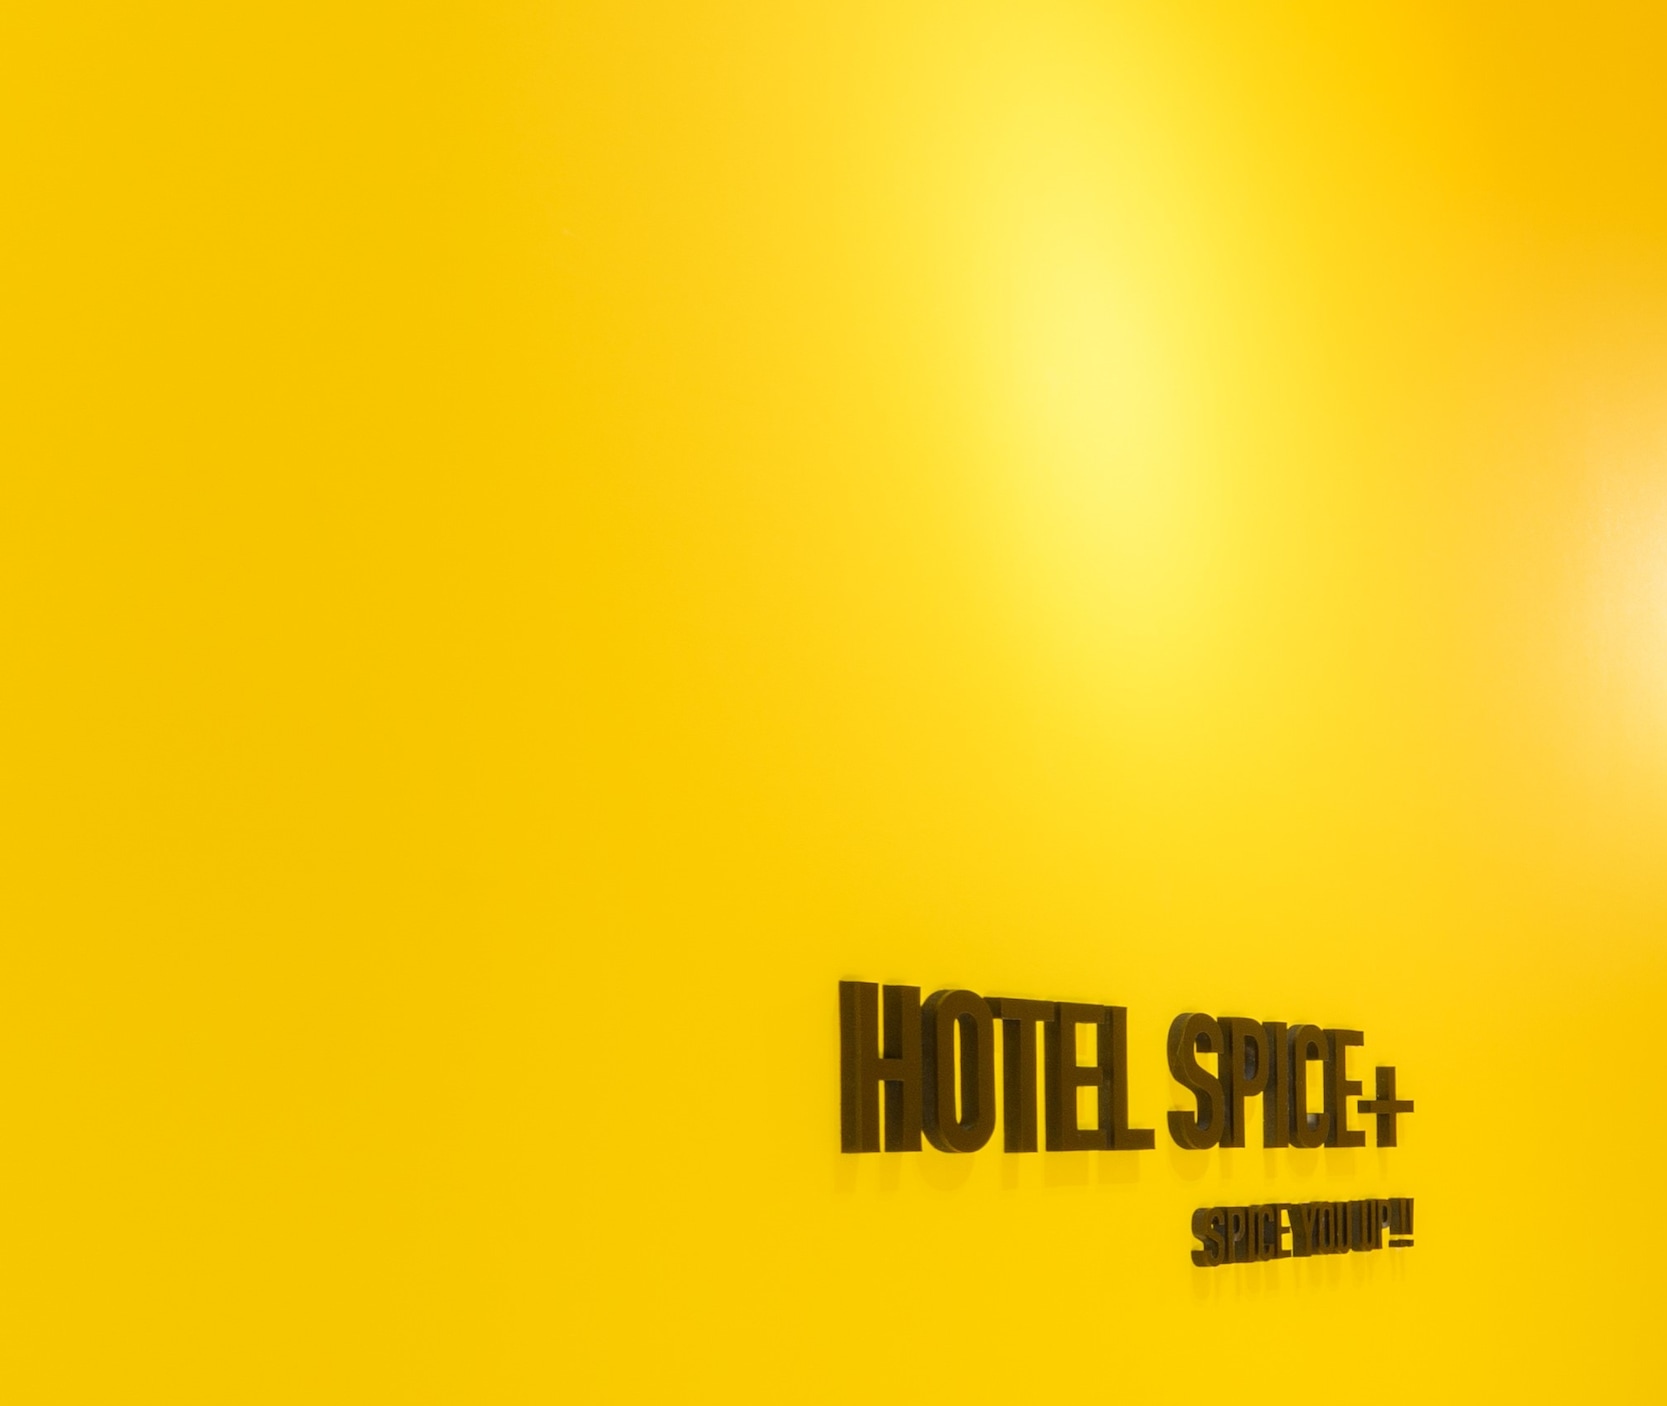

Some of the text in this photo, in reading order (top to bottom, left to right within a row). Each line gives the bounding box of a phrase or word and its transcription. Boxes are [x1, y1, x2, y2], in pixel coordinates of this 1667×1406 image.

[839, 980, 1414, 1153] HOTEL SPICE+
[1189, 1204, 1292, 1267] SPICE
[1285, 1201, 1350, 1257] YOU
